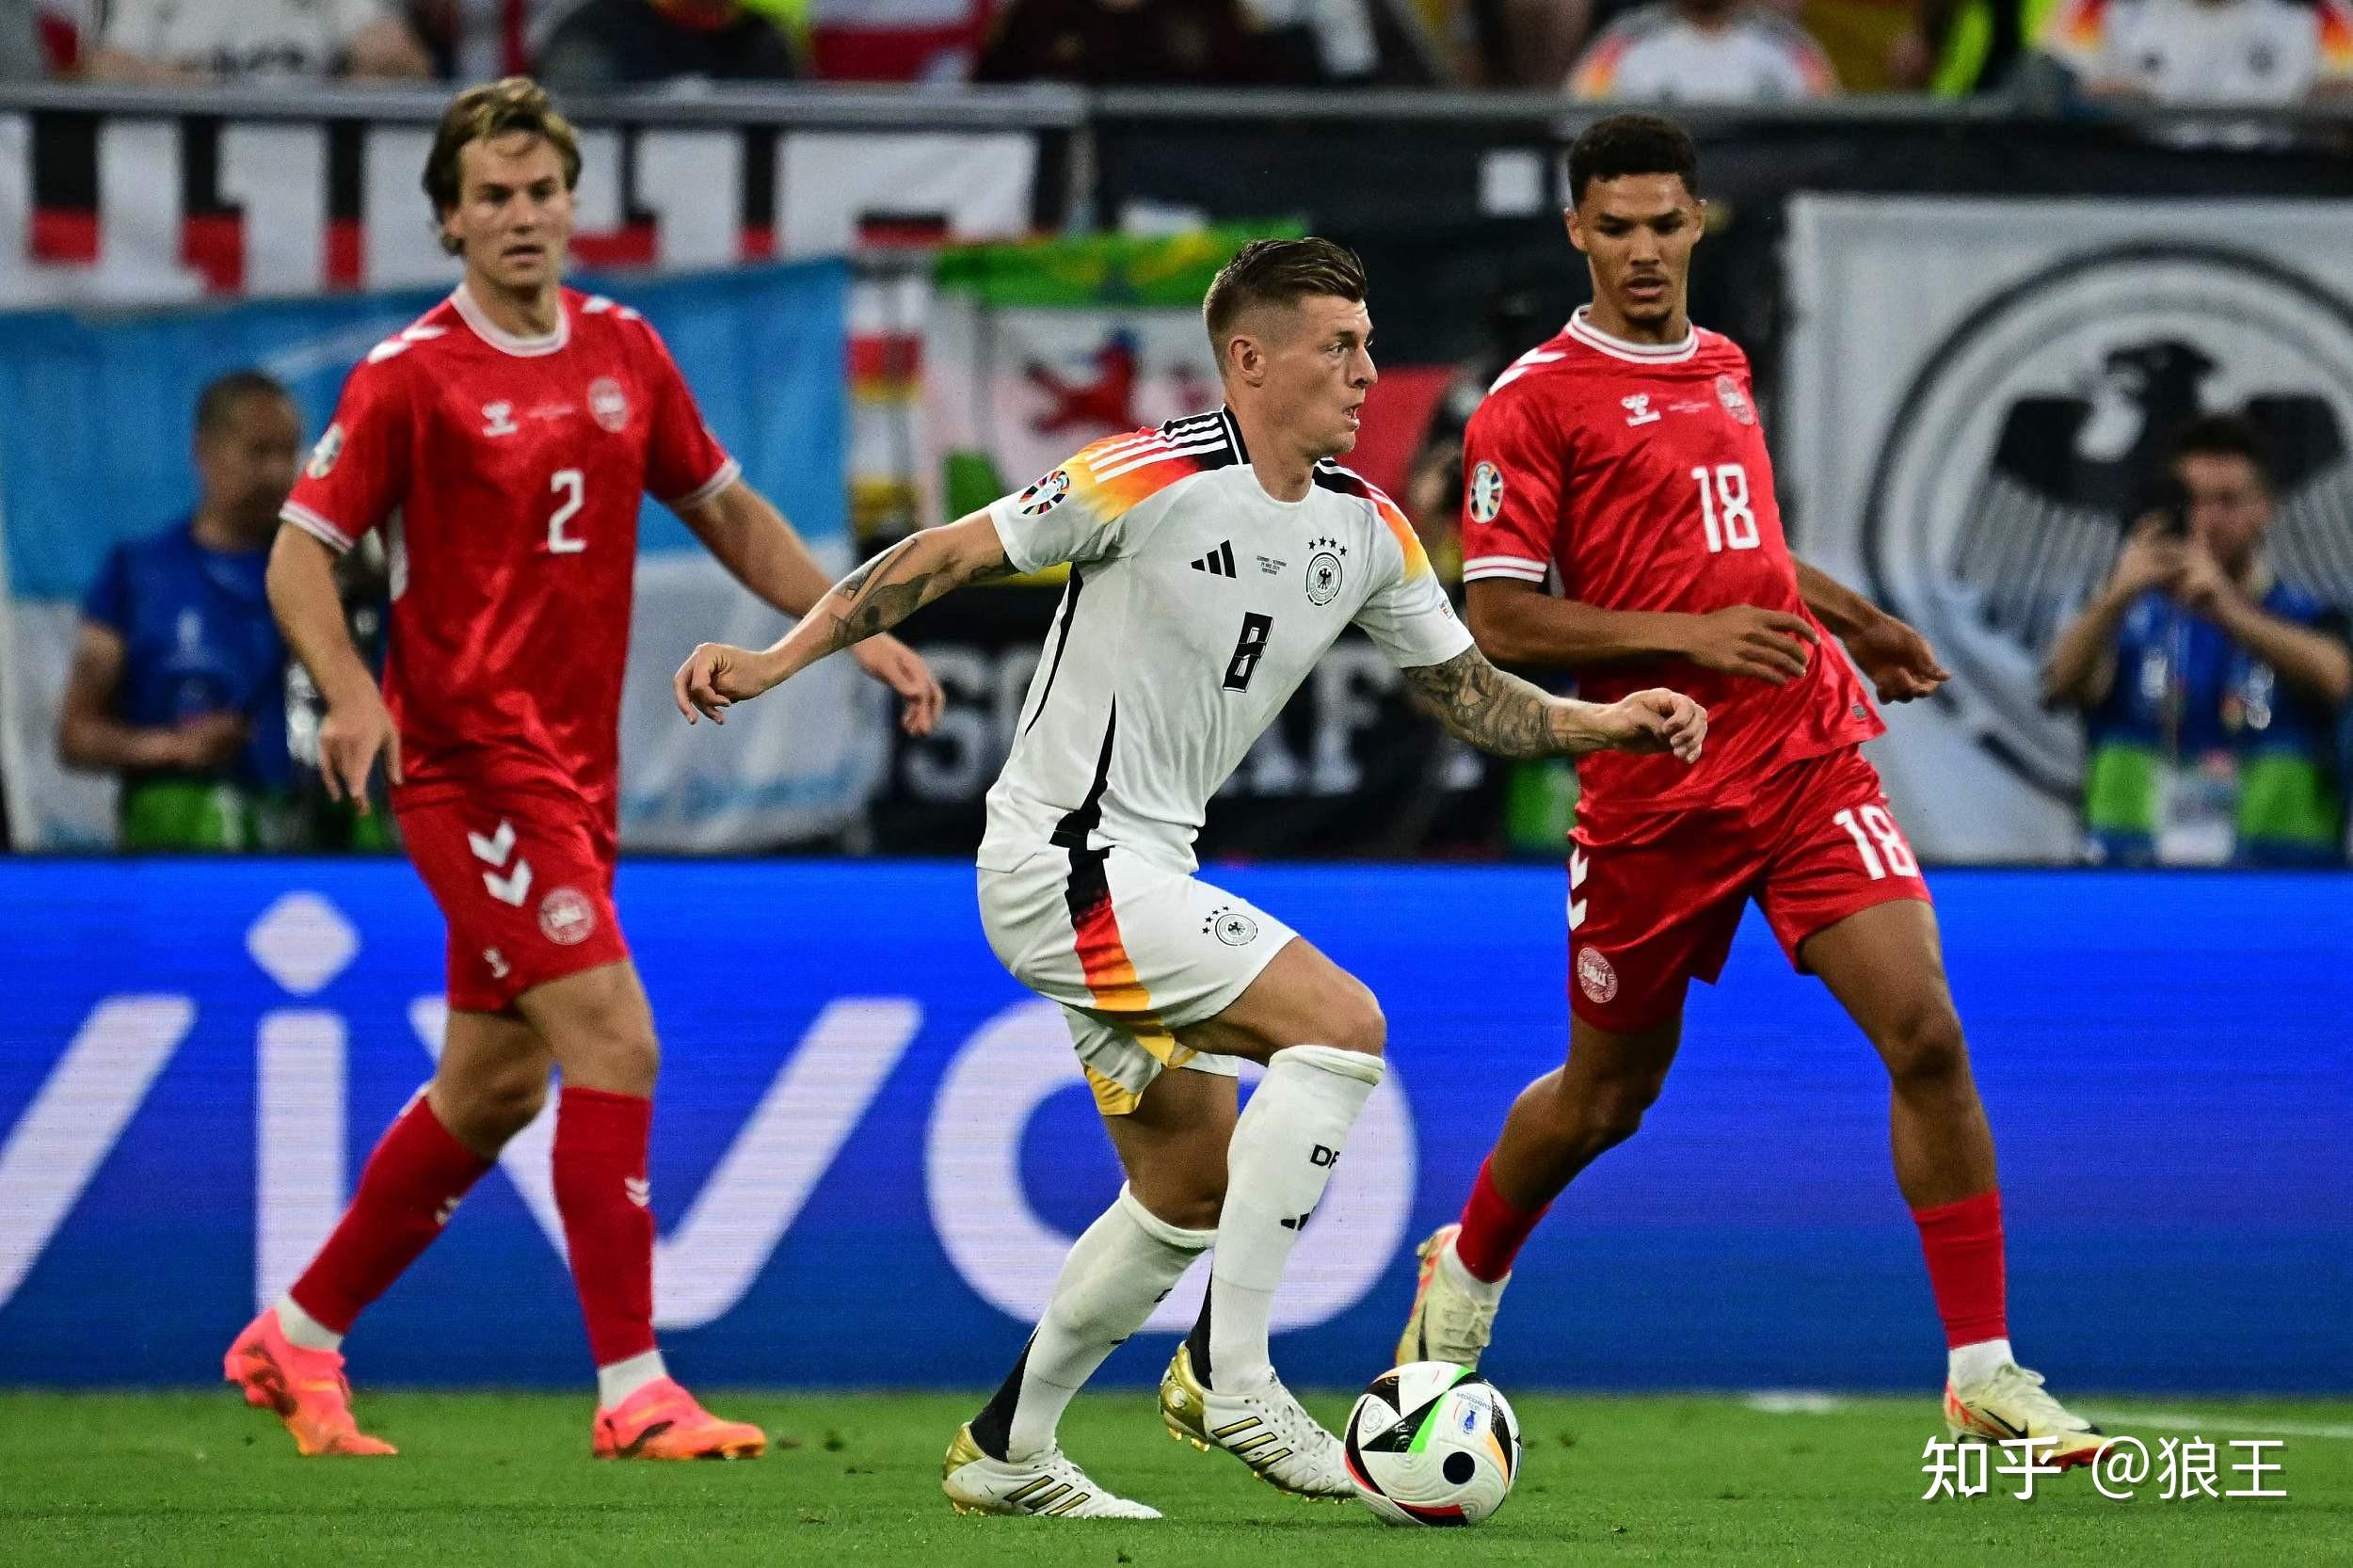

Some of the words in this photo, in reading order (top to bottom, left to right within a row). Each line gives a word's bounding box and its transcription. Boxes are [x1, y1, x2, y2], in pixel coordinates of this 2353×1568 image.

[548, 470, 587, 553] 2
[1691, 463, 1761, 552] 18
[1223, 611, 1274, 693] 8
[1833, 804, 1918, 881] 18
